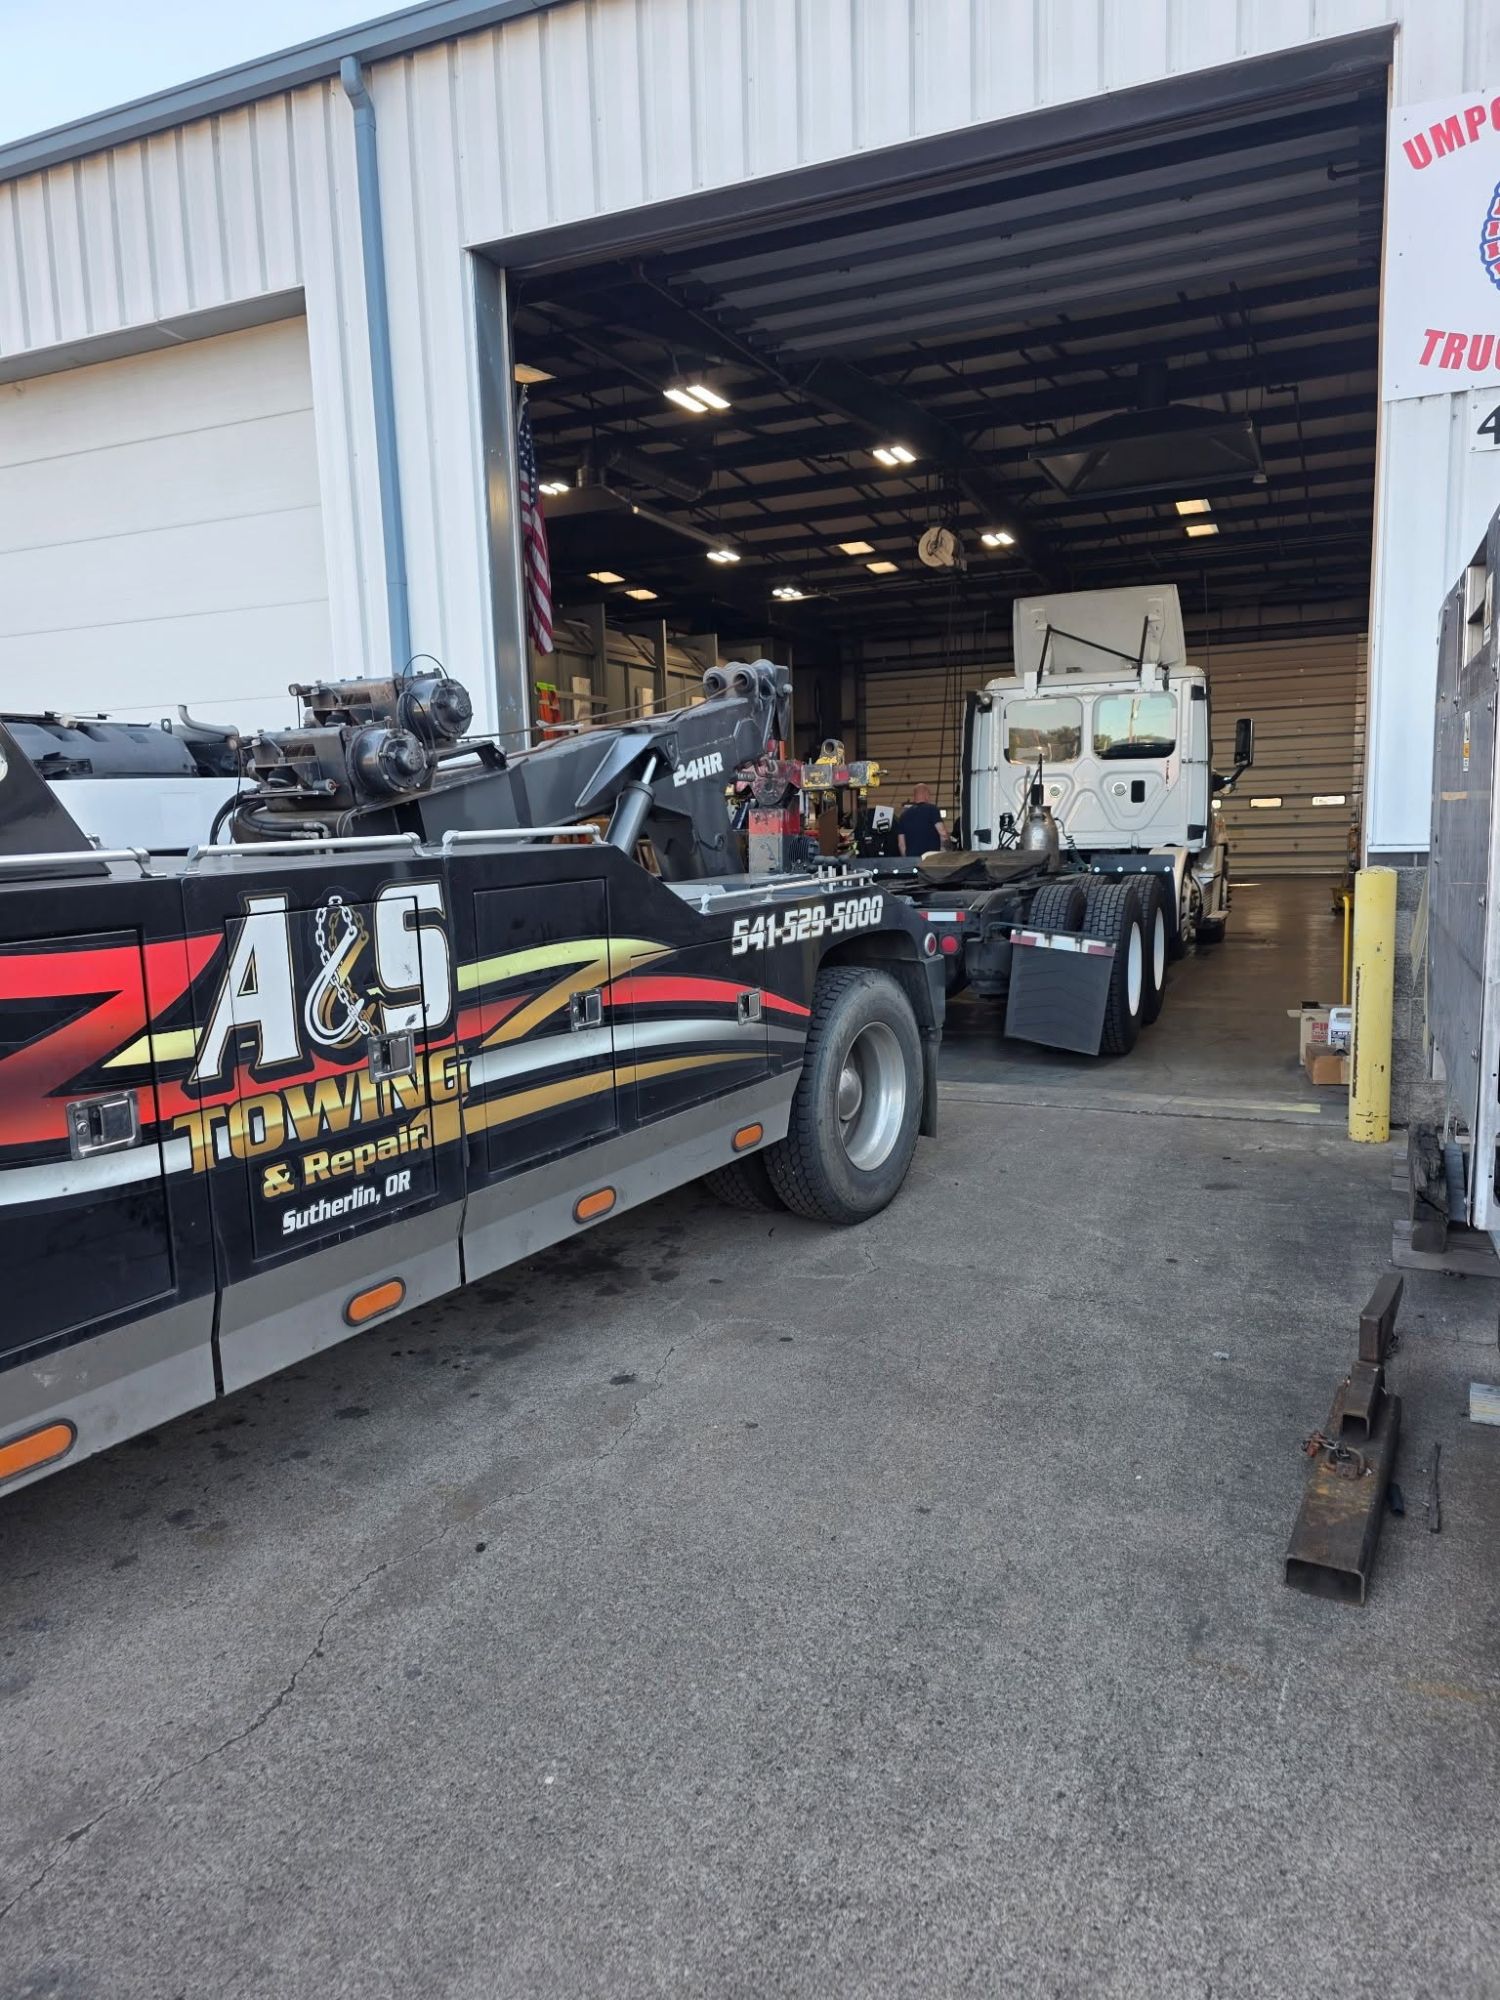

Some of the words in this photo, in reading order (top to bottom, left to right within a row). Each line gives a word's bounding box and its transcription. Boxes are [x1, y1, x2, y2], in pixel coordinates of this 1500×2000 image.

[673, 752, 724, 788] 24HR
[732, 895, 884, 956] 541-529-5000
[173, 1047, 468, 1174] TOWING
[263, 1163, 294, 1198] &
[304, 1124, 428, 1185] Repair
[282, 1183, 382, 1235] Sutherlin,
[385, 1170, 411, 1198] OR
